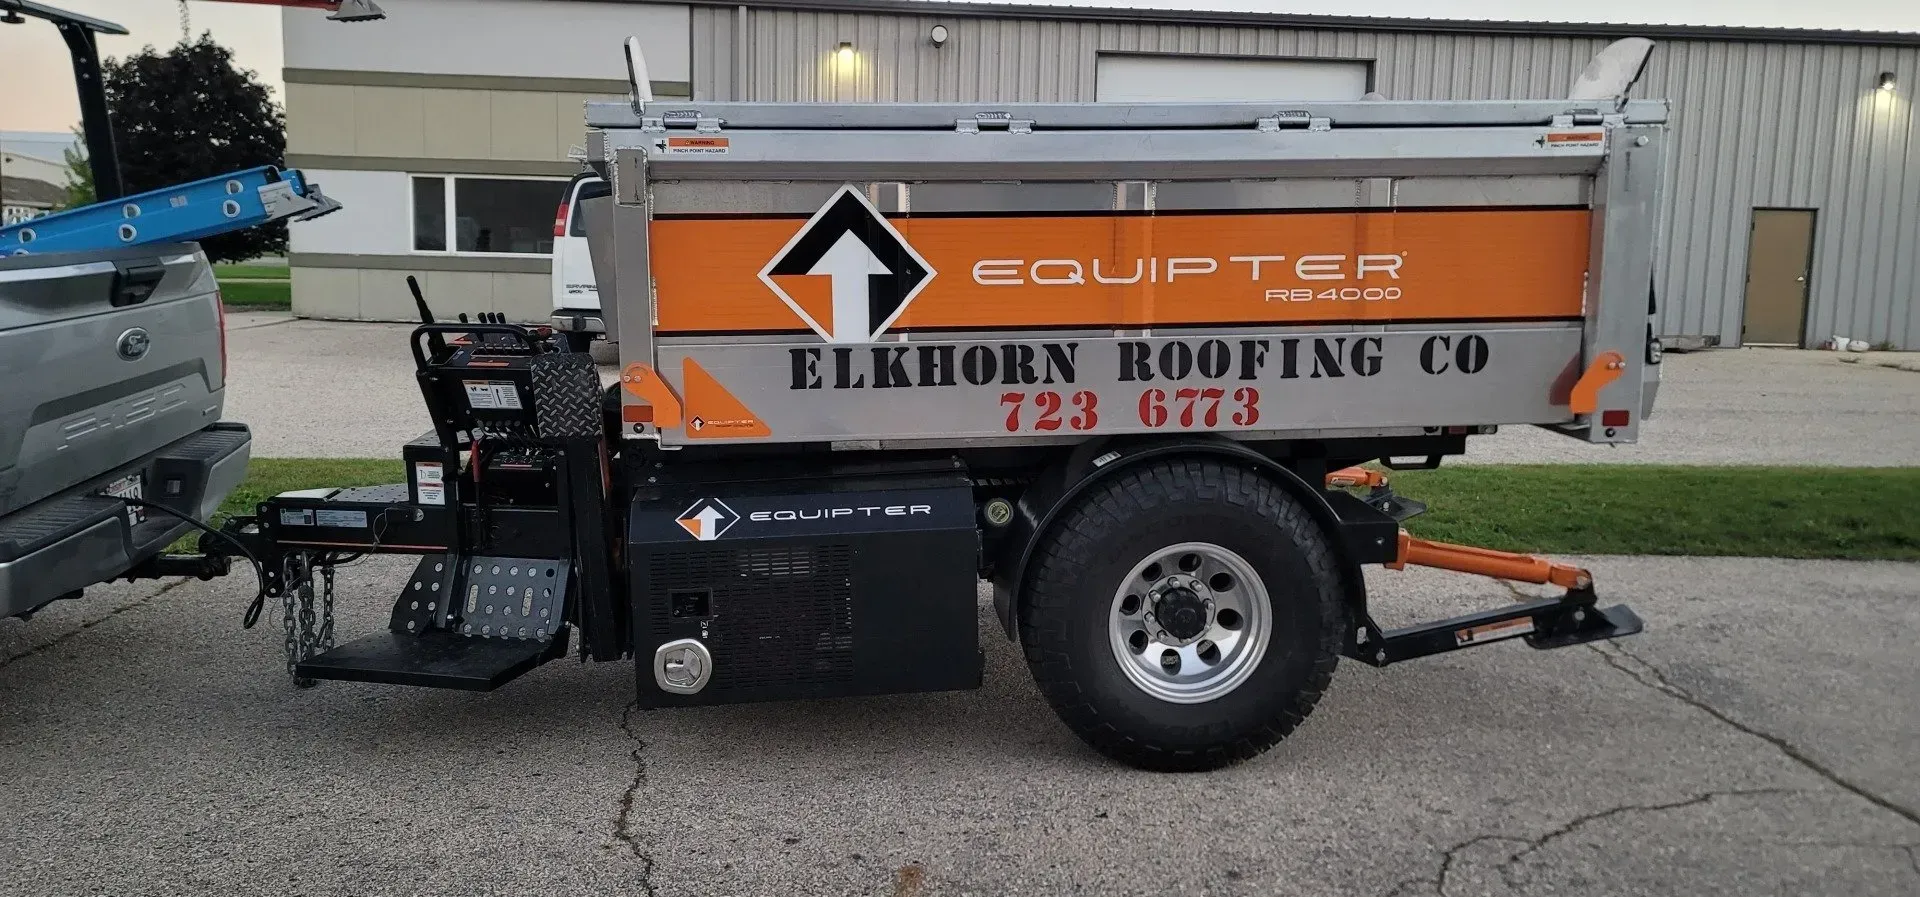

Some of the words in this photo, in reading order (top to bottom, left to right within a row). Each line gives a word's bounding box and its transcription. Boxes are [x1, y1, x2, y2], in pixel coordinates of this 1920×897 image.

[972, 254, 1403, 285] EQUIPTER
[1264, 287, 1402, 302] RB4000
[788, 342, 1080, 390] ELKHORN
[1117, 337, 1384, 382] ROOFING
[1419, 334, 1490, 376] CO
[1000, 391, 1099, 432] 723
[1138, 387, 1261, 428] 6773
[749, 504, 932, 521] EQUIPTER
